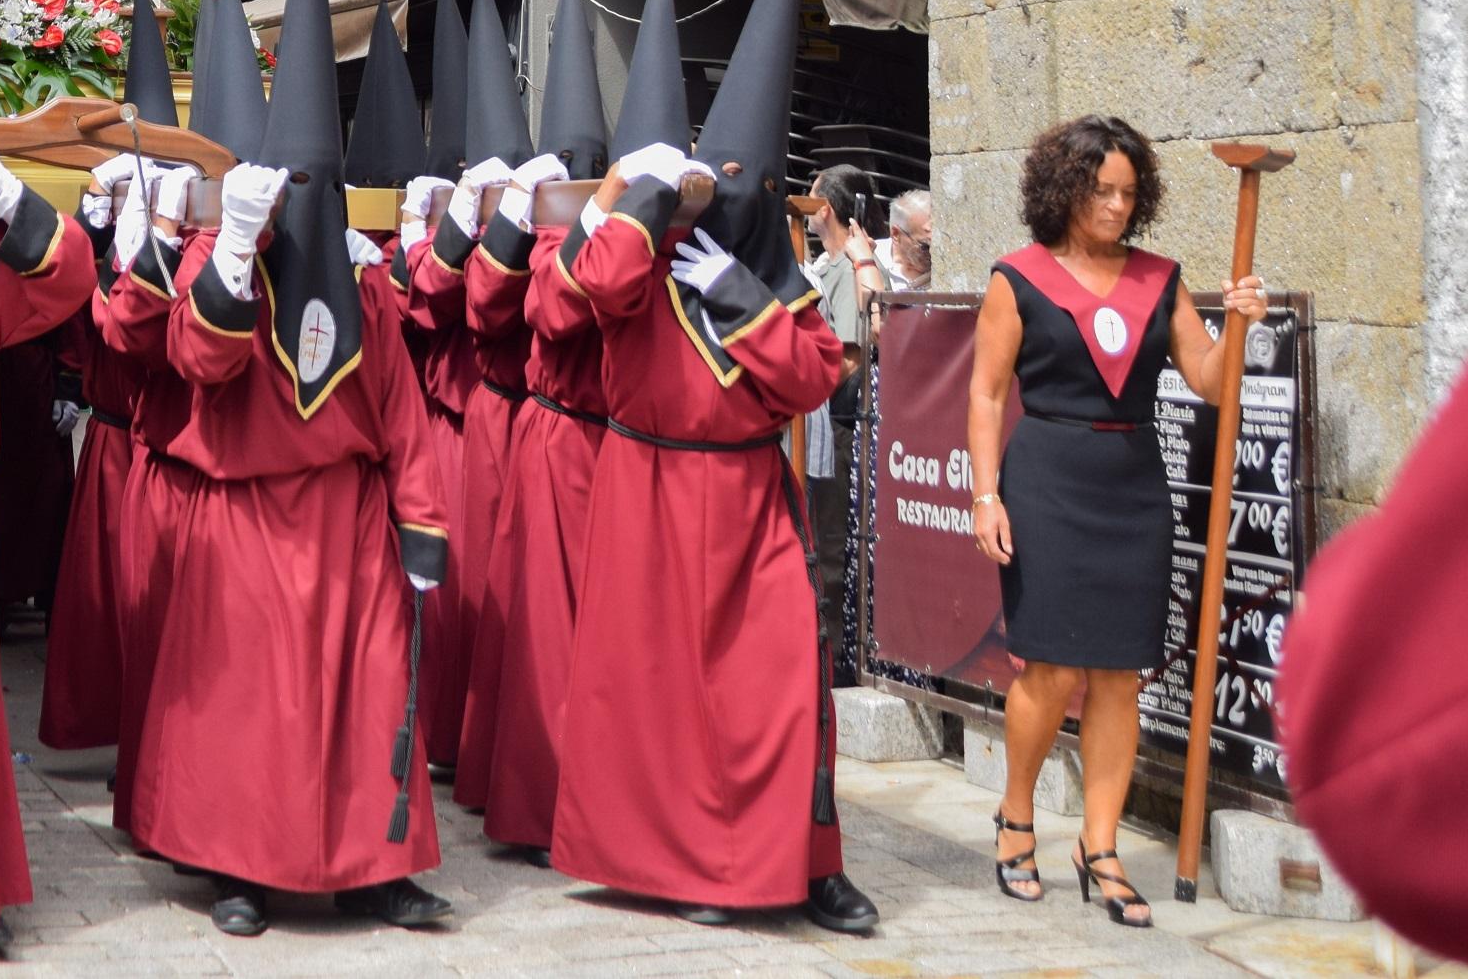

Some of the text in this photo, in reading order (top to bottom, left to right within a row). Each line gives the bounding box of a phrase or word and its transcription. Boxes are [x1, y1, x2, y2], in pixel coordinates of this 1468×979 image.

[1160, 401, 1195, 419] Diario
[1160, 420, 1183, 437] Plato
[1167, 435, 1191, 454] Plato
[889, 441, 973, 492] Casa Eli
[1160, 449, 1188, 467] ebida
[896, 497, 974, 535] RESTAURA
